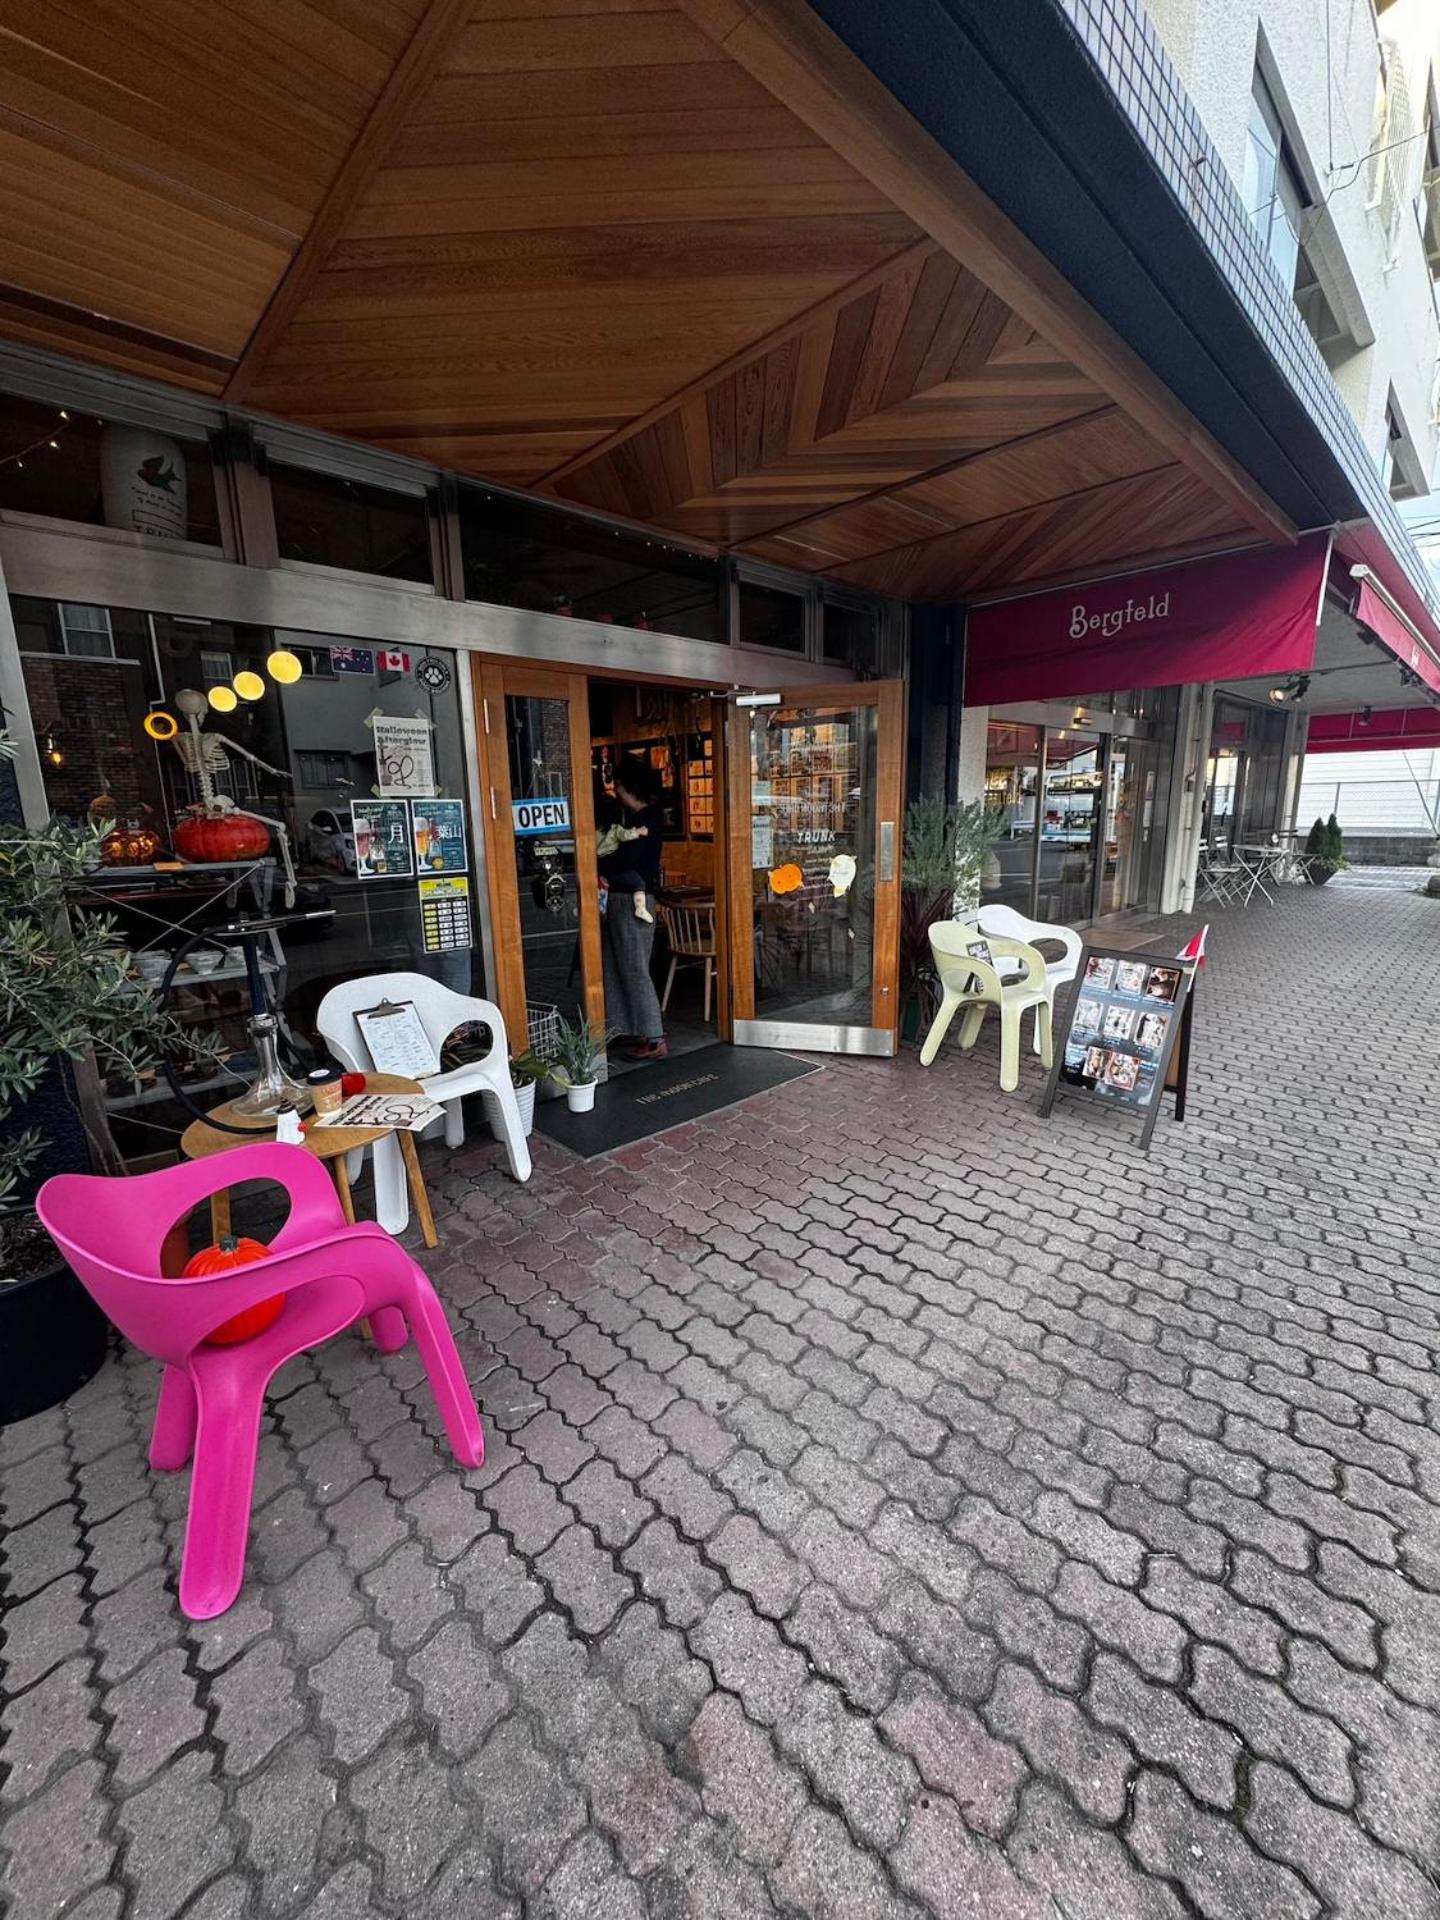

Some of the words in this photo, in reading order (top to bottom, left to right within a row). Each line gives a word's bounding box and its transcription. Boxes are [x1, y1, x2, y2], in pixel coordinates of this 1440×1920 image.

[1069, 591, 1169, 638] Bergfeld
[518, 803, 565, 828] OPEN
[388, 823, 404, 844] 月
[797, 831, 836, 844] TRUNK
